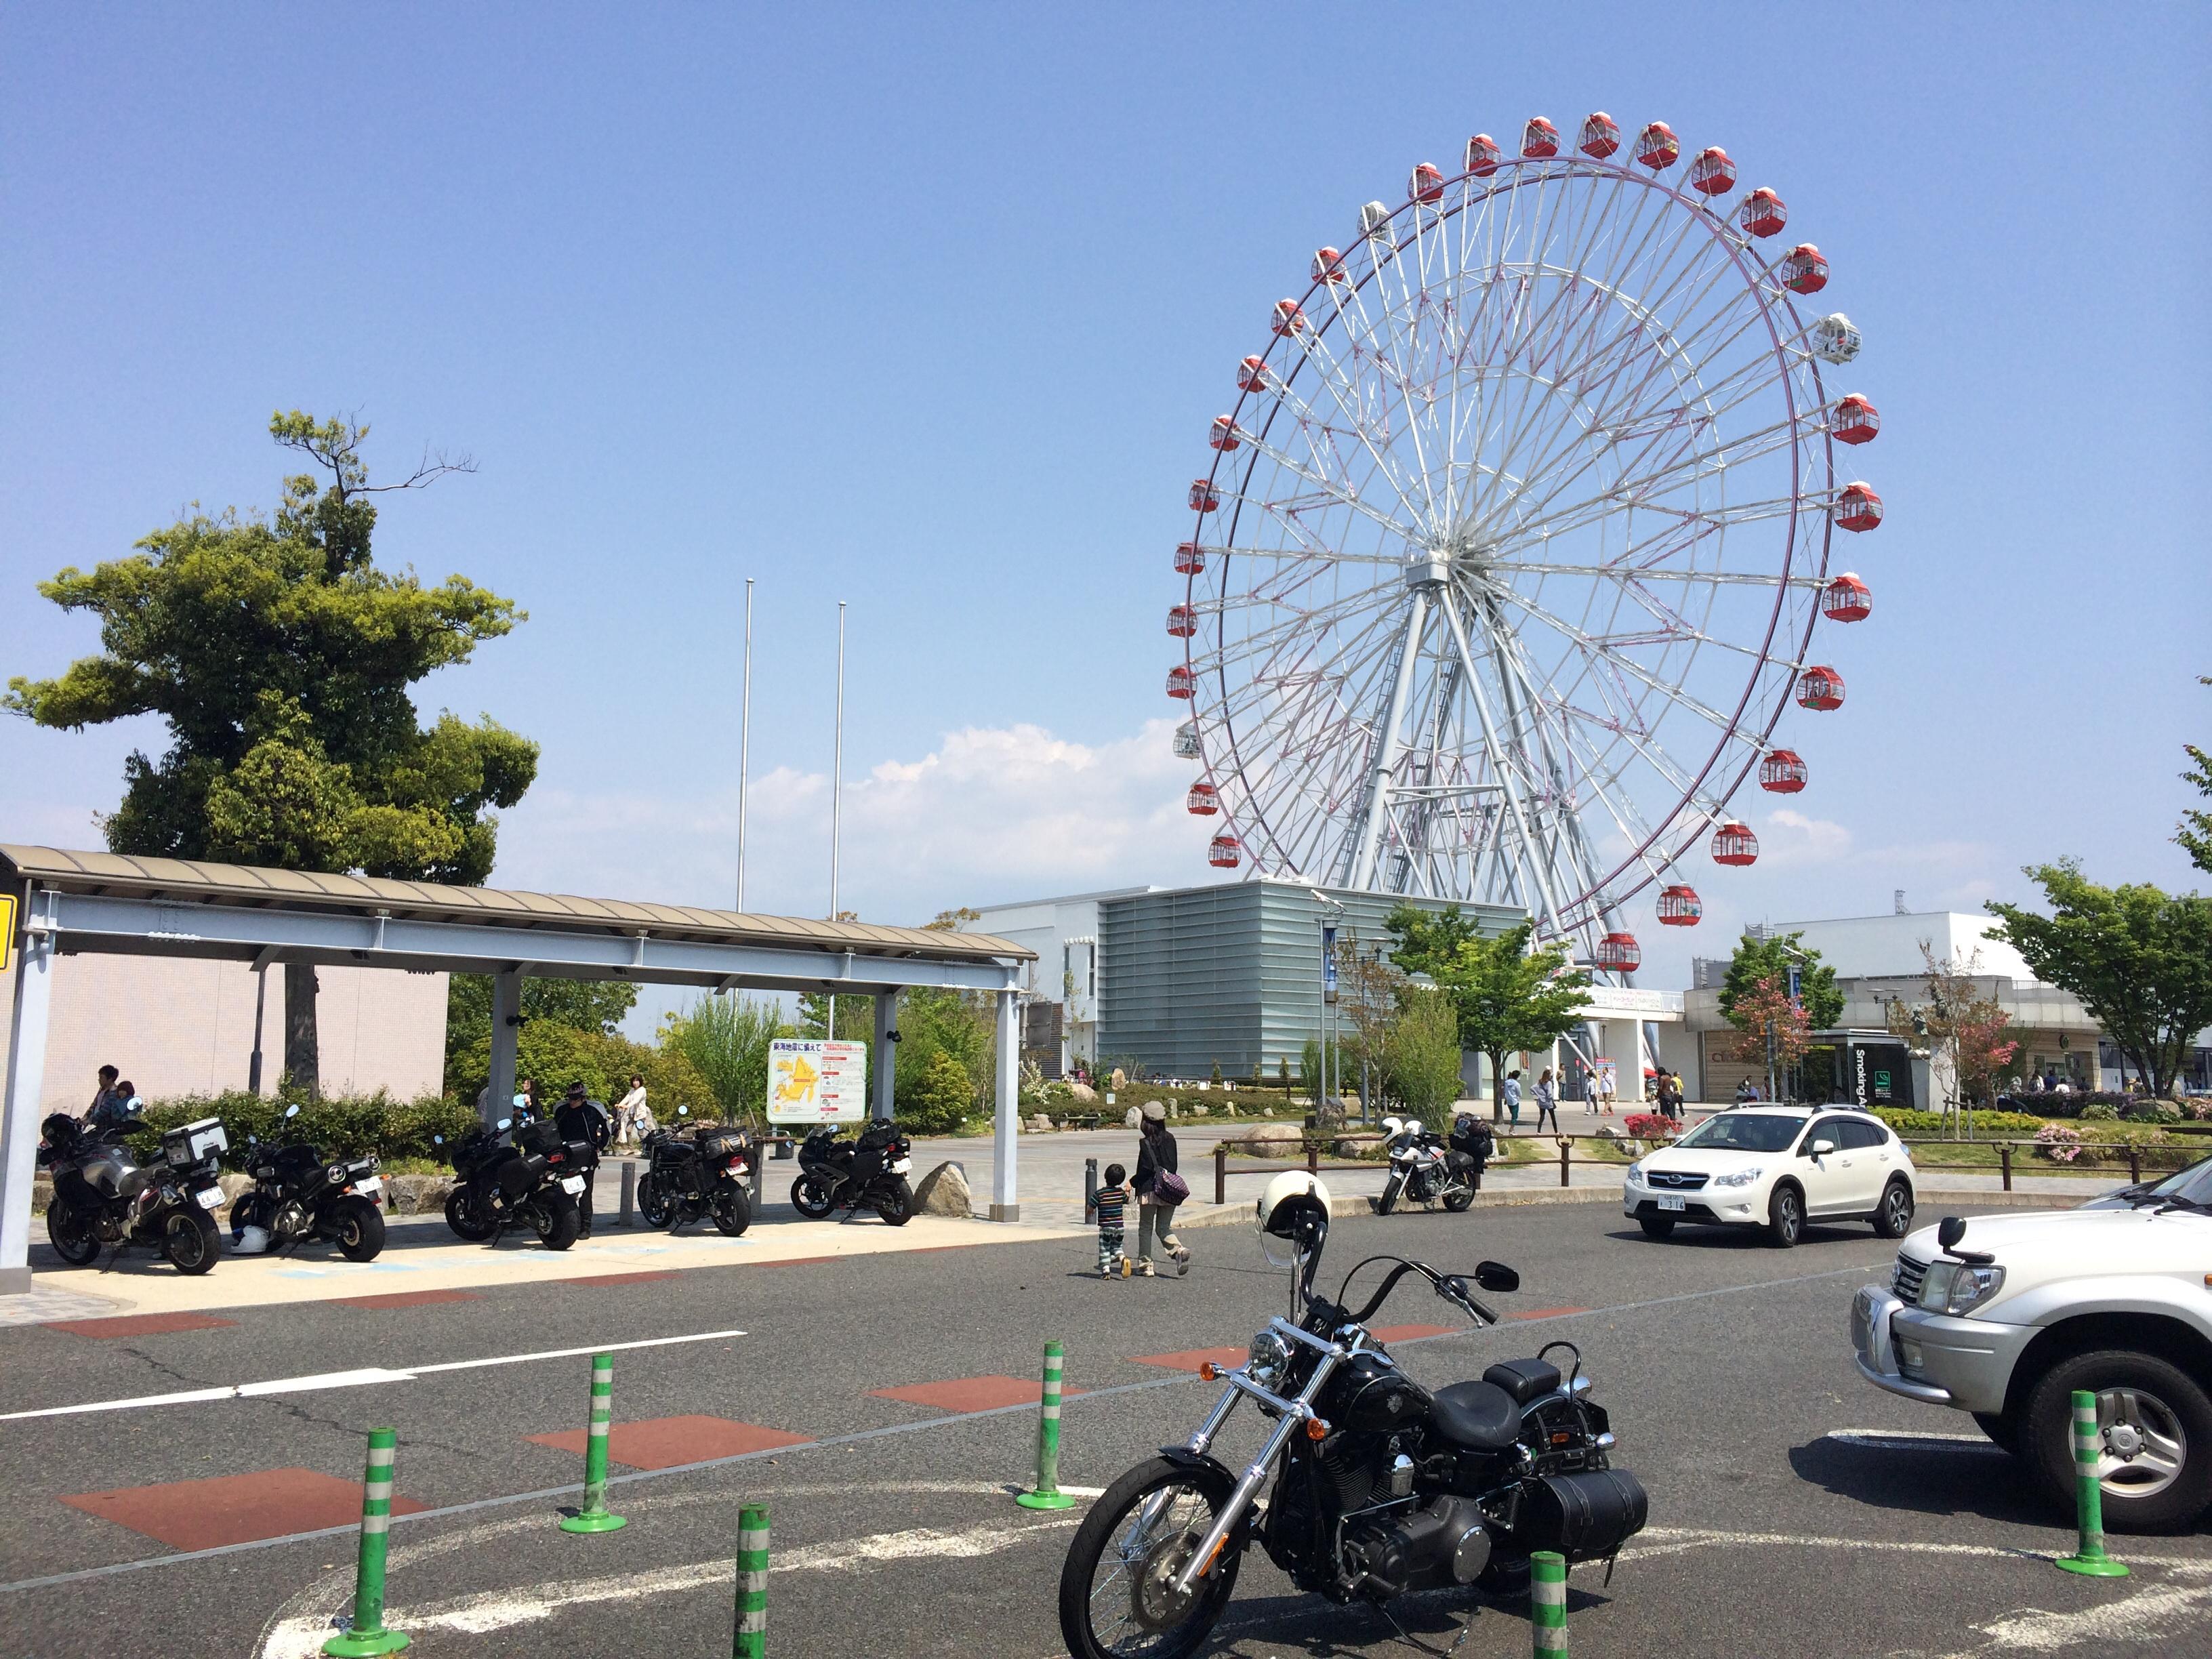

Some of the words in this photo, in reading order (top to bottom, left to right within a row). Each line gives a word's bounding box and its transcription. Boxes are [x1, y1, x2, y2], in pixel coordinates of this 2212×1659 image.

[773, 1042, 821, 1052] 東海地震に備えて
[1856, 1049, 1866, 1096] Smoking
